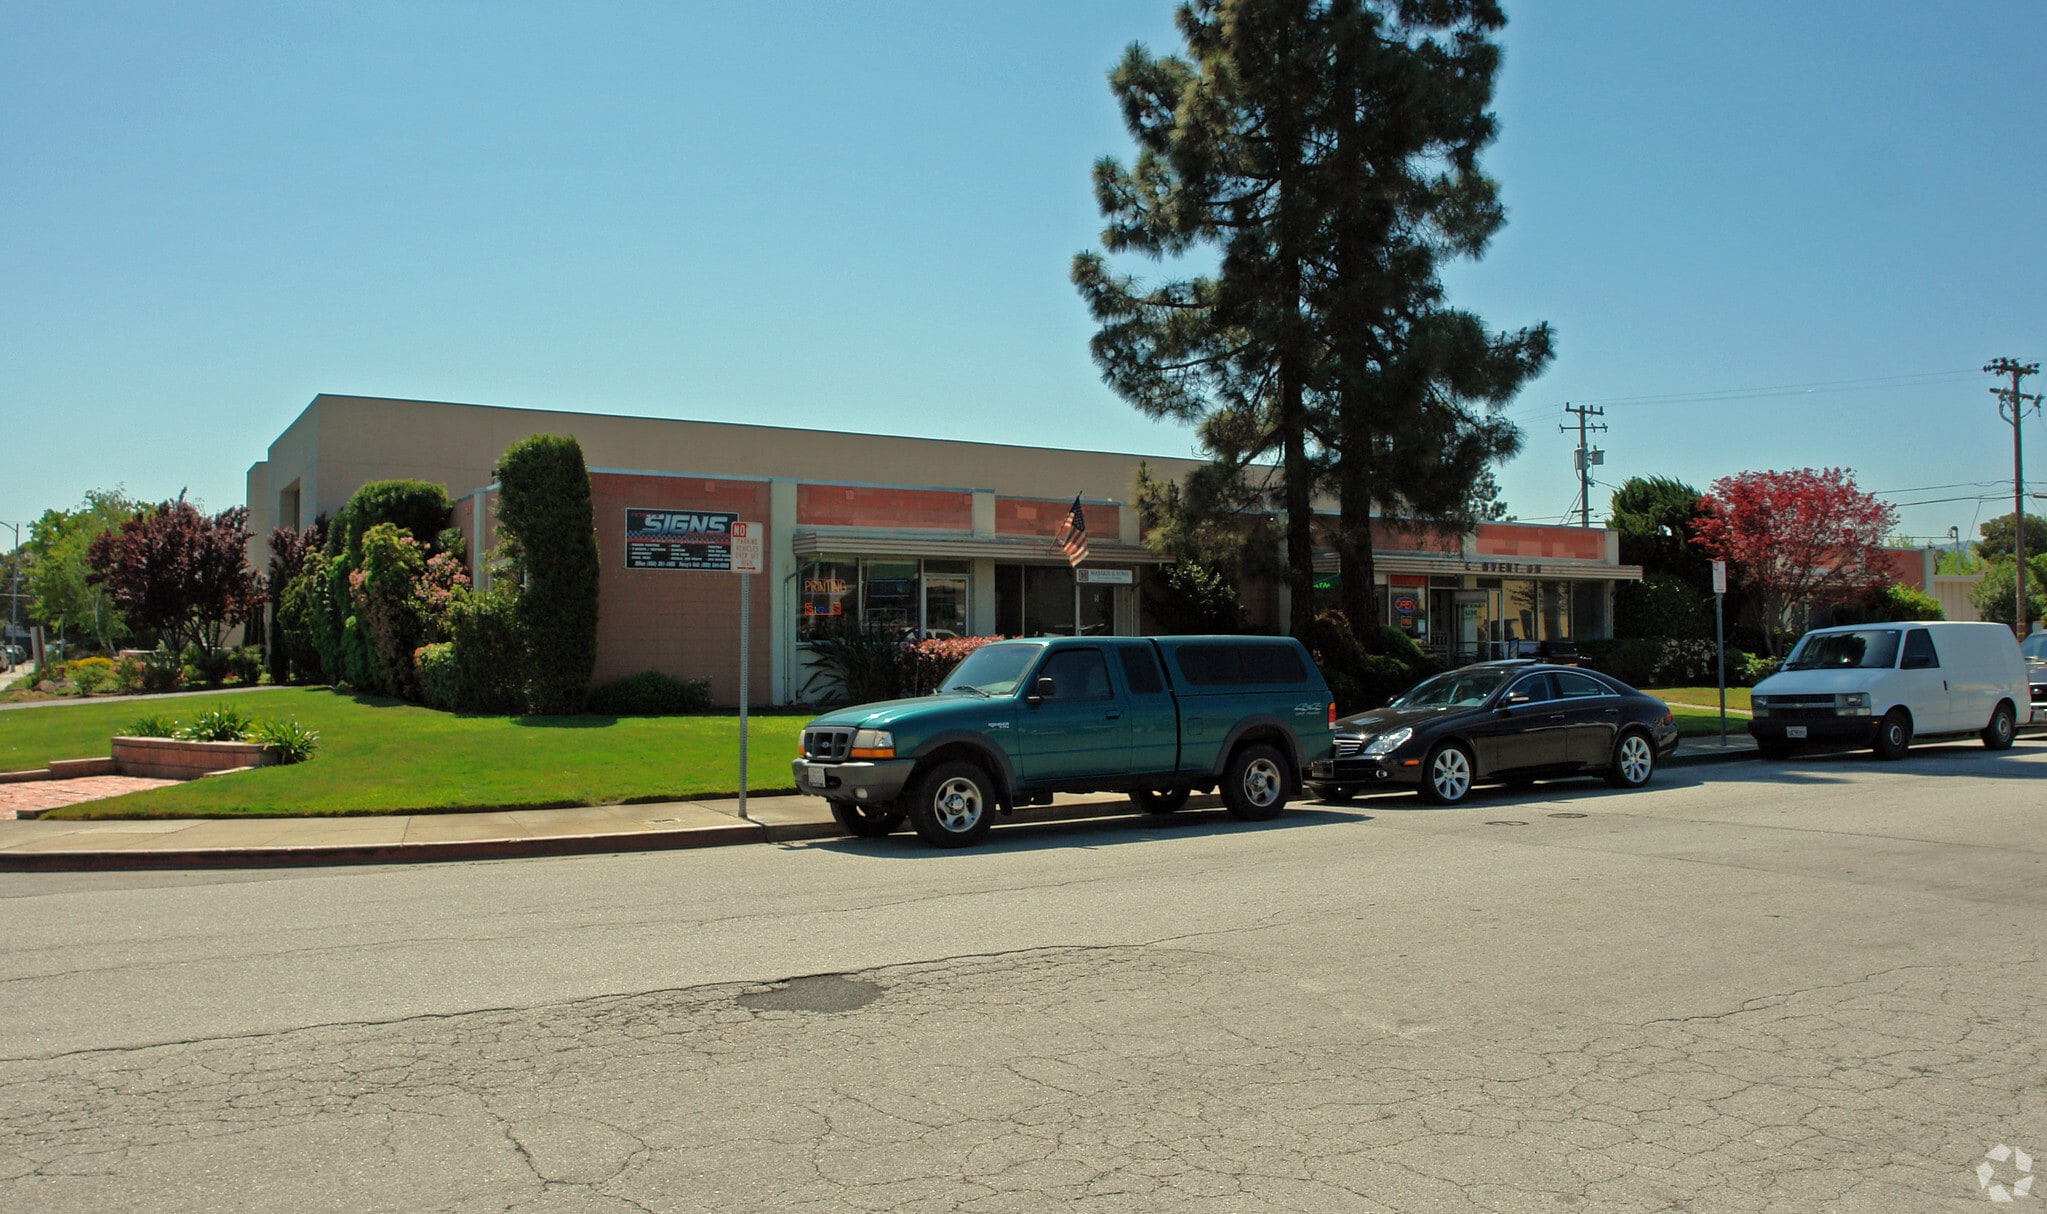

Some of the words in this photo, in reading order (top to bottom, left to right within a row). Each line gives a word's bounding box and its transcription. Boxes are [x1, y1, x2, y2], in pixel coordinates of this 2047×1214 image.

[640, 513, 728, 534] SIGNS
[734, 525, 746, 537] NO
[804, 580, 847, 593] PRINTING
[1395, 600, 1417, 610] OPEN
